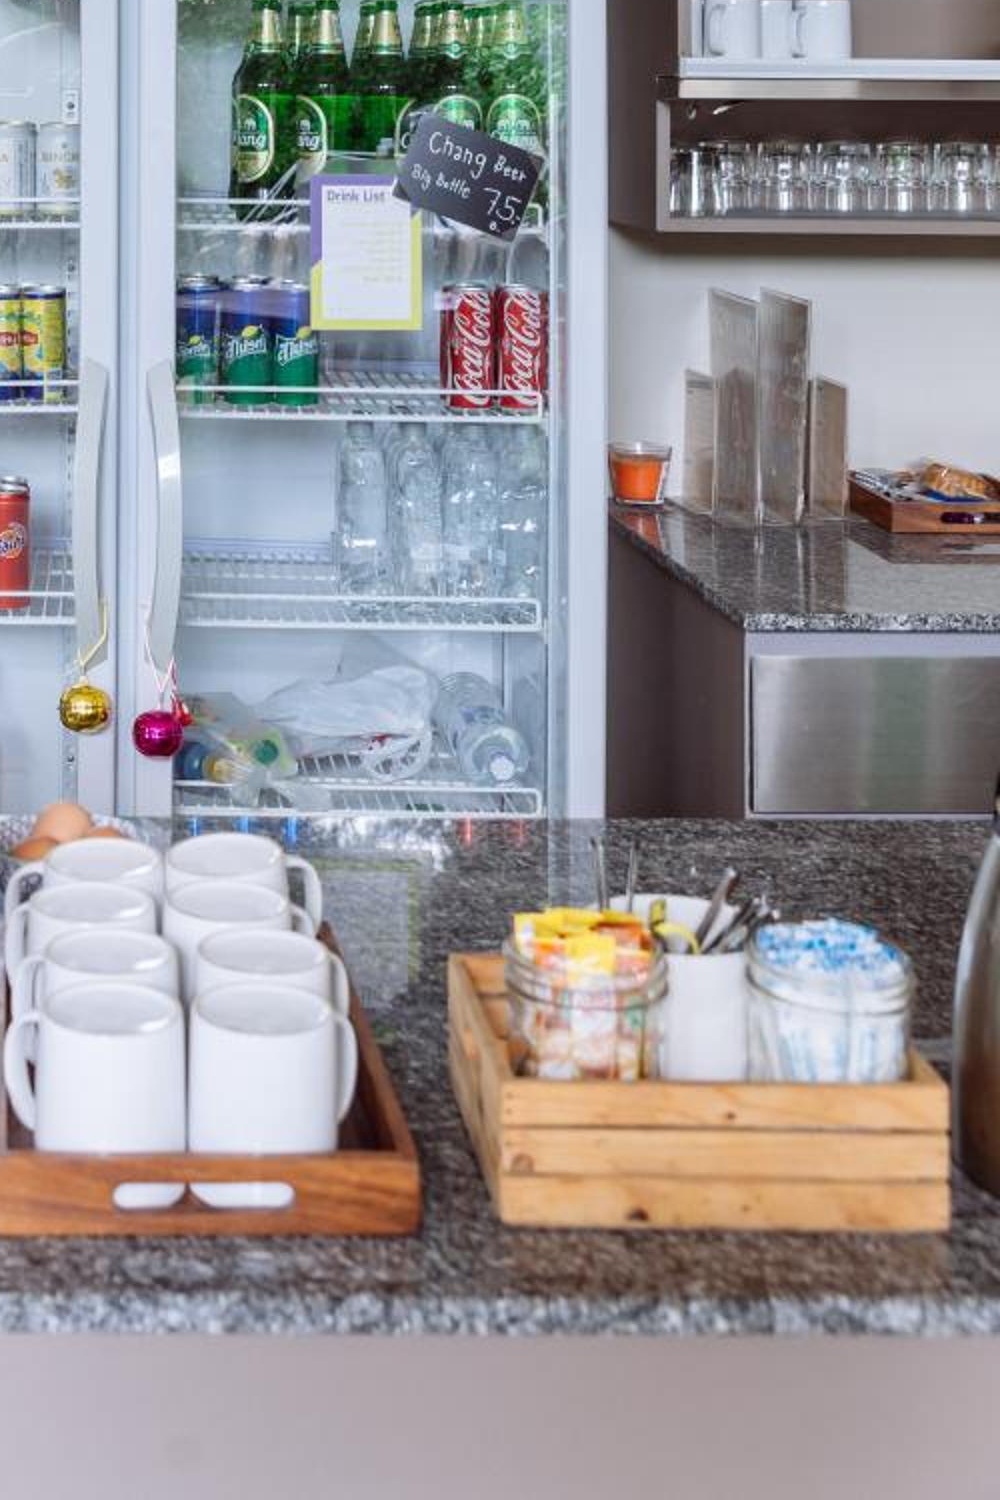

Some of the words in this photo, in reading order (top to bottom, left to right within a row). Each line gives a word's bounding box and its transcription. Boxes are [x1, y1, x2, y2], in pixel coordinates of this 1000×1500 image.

[428, 131, 488, 180] Chang
[493, 154, 528, 183] Beer
[327, 190, 360, 202] Drink
[363, 190, 386, 202] List
[410, 163, 432, 192] Big
[435, 171, 471, 199] Bottle
